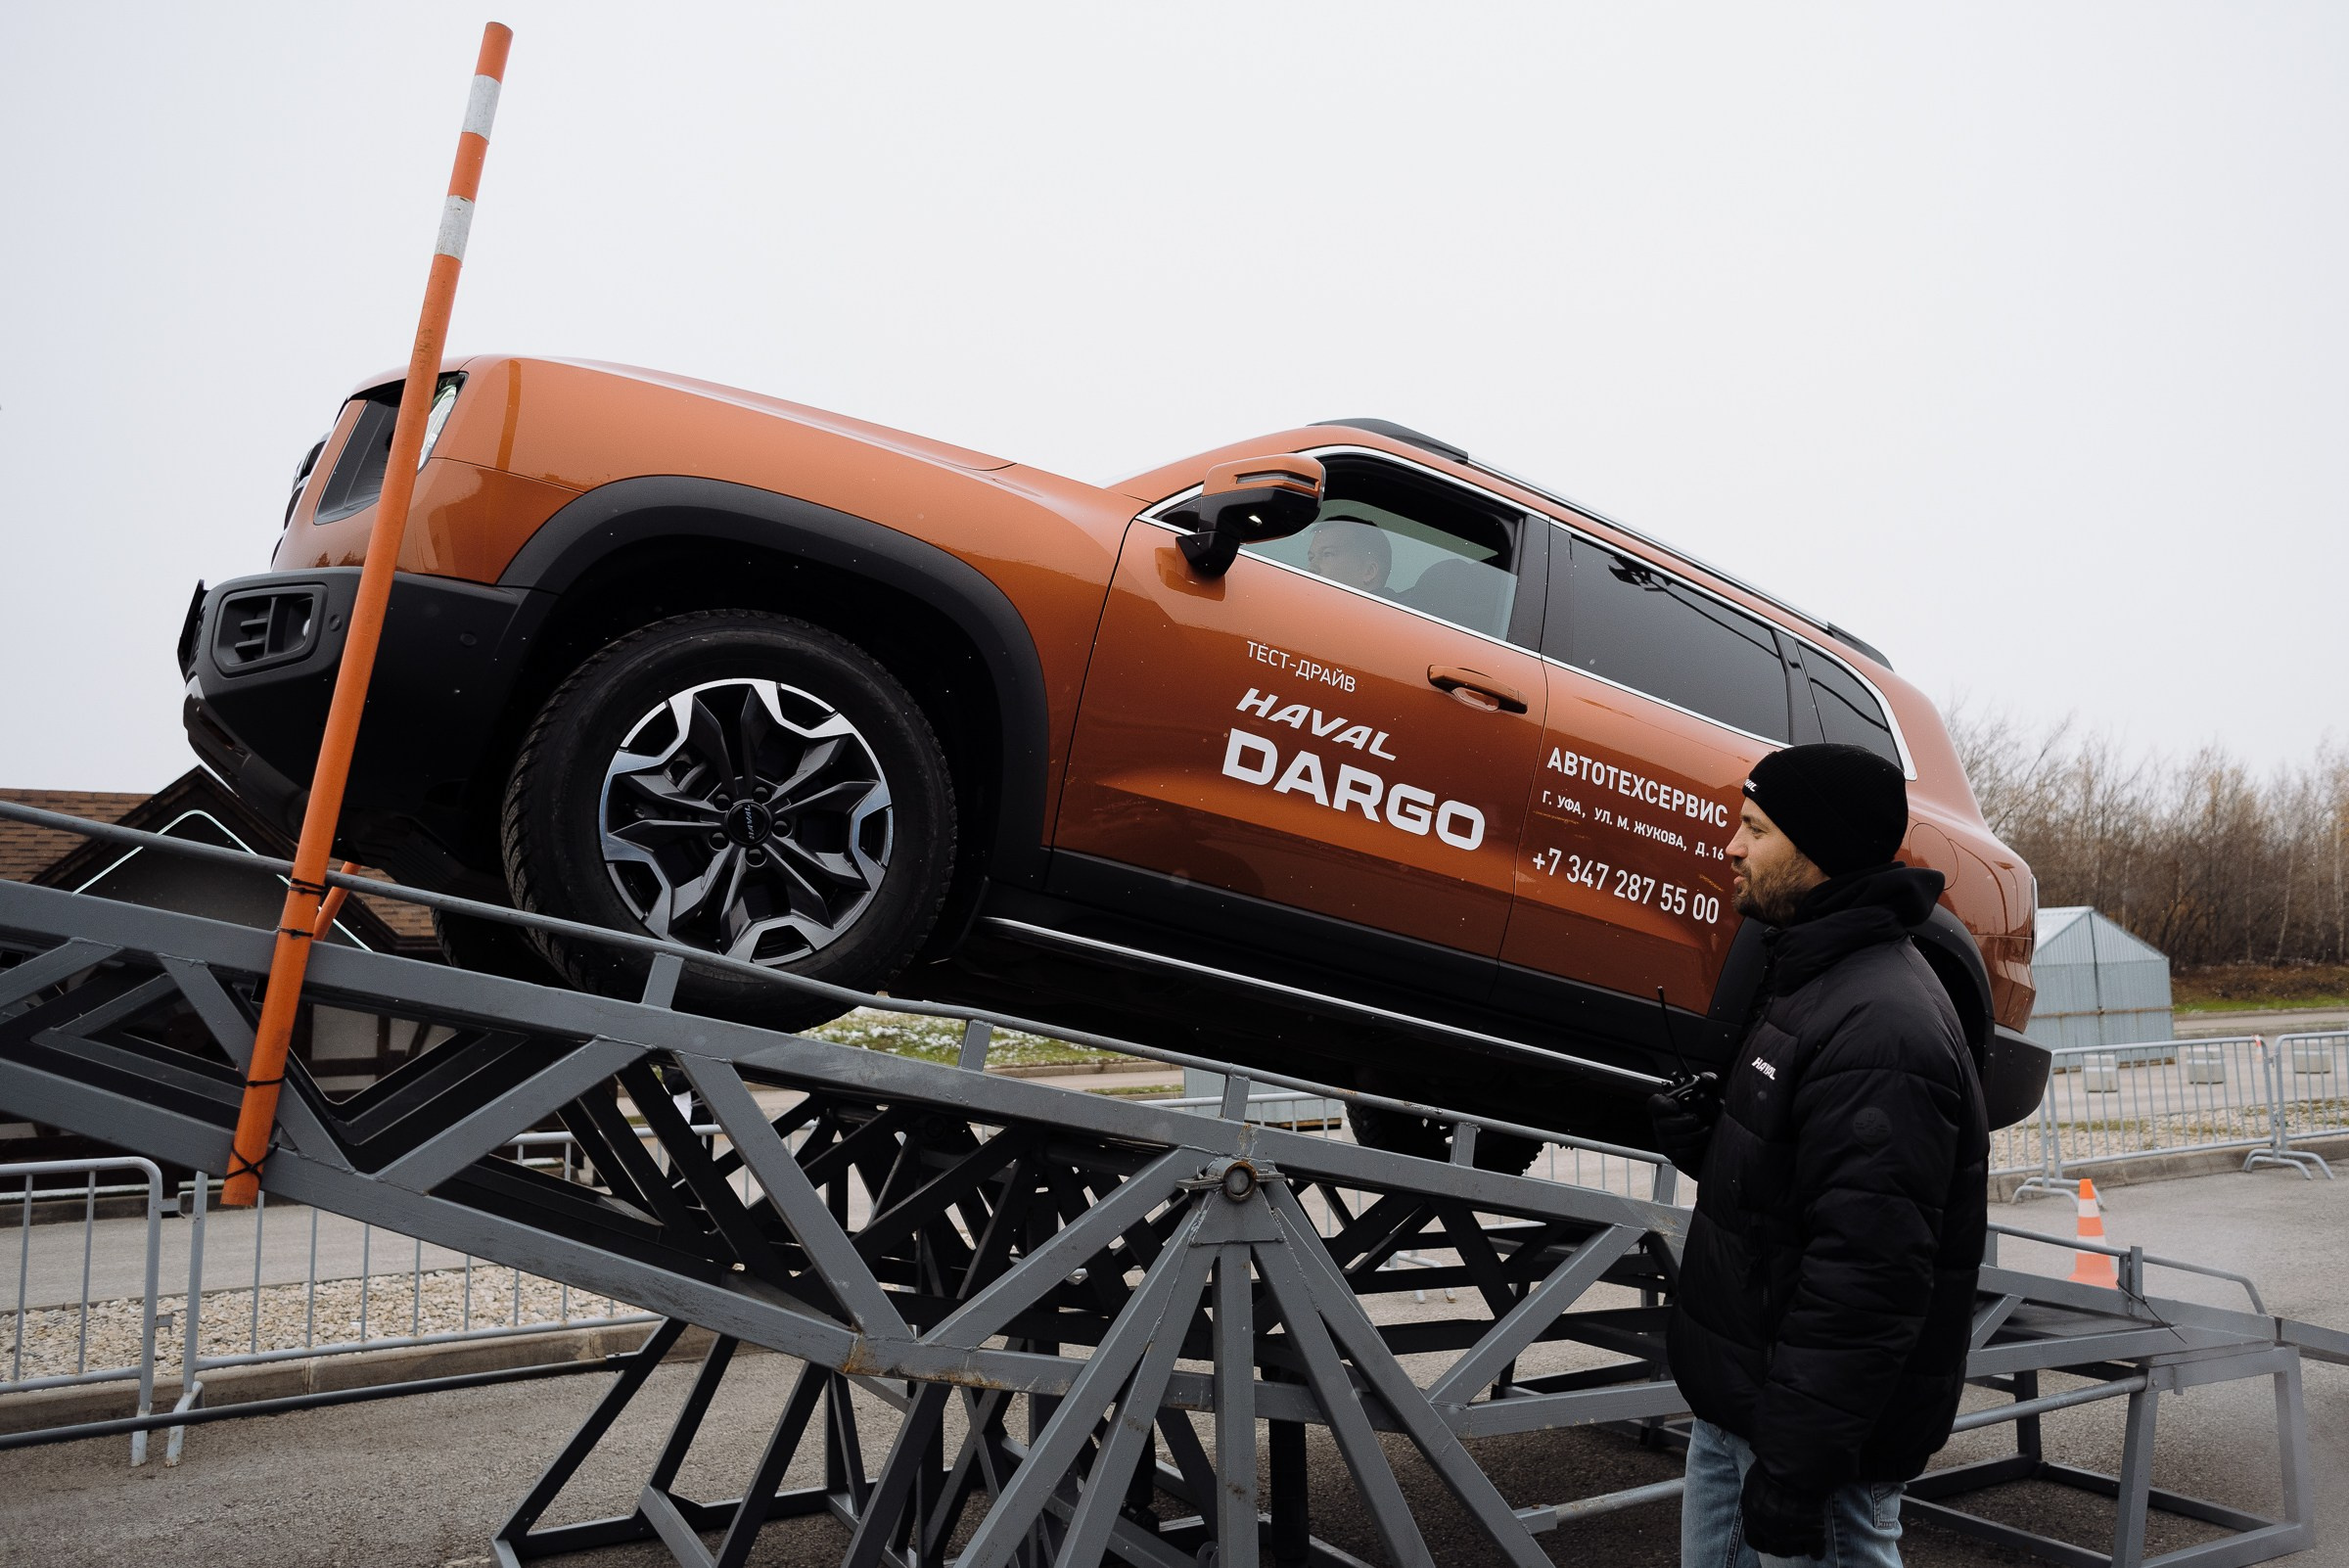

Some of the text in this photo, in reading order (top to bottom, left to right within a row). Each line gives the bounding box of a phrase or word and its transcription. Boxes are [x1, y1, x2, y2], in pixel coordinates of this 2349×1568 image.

[1246, 640, 1357, 693] ТЕСТ-ДРАЙВ
[1236, 687, 1397, 761] HAVAL
[1221, 727, 1486, 852] DARGO
[1542, 790, 1552, 806] Г.
[1556, 795, 1587, 818] УФА,
[1594, 807, 1613, 826] УЛ.
[1617, 815, 1630, 831] М.
[1634, 820, 1687, 852] ЖУКОВА,
[1546, 746, 1729, 828] АВТОТЕХСЕРВИС
[1532, 848, 1720, 924] +7 347 287 55 00
[1751, 1056, 1776, 1081] HAVAL
